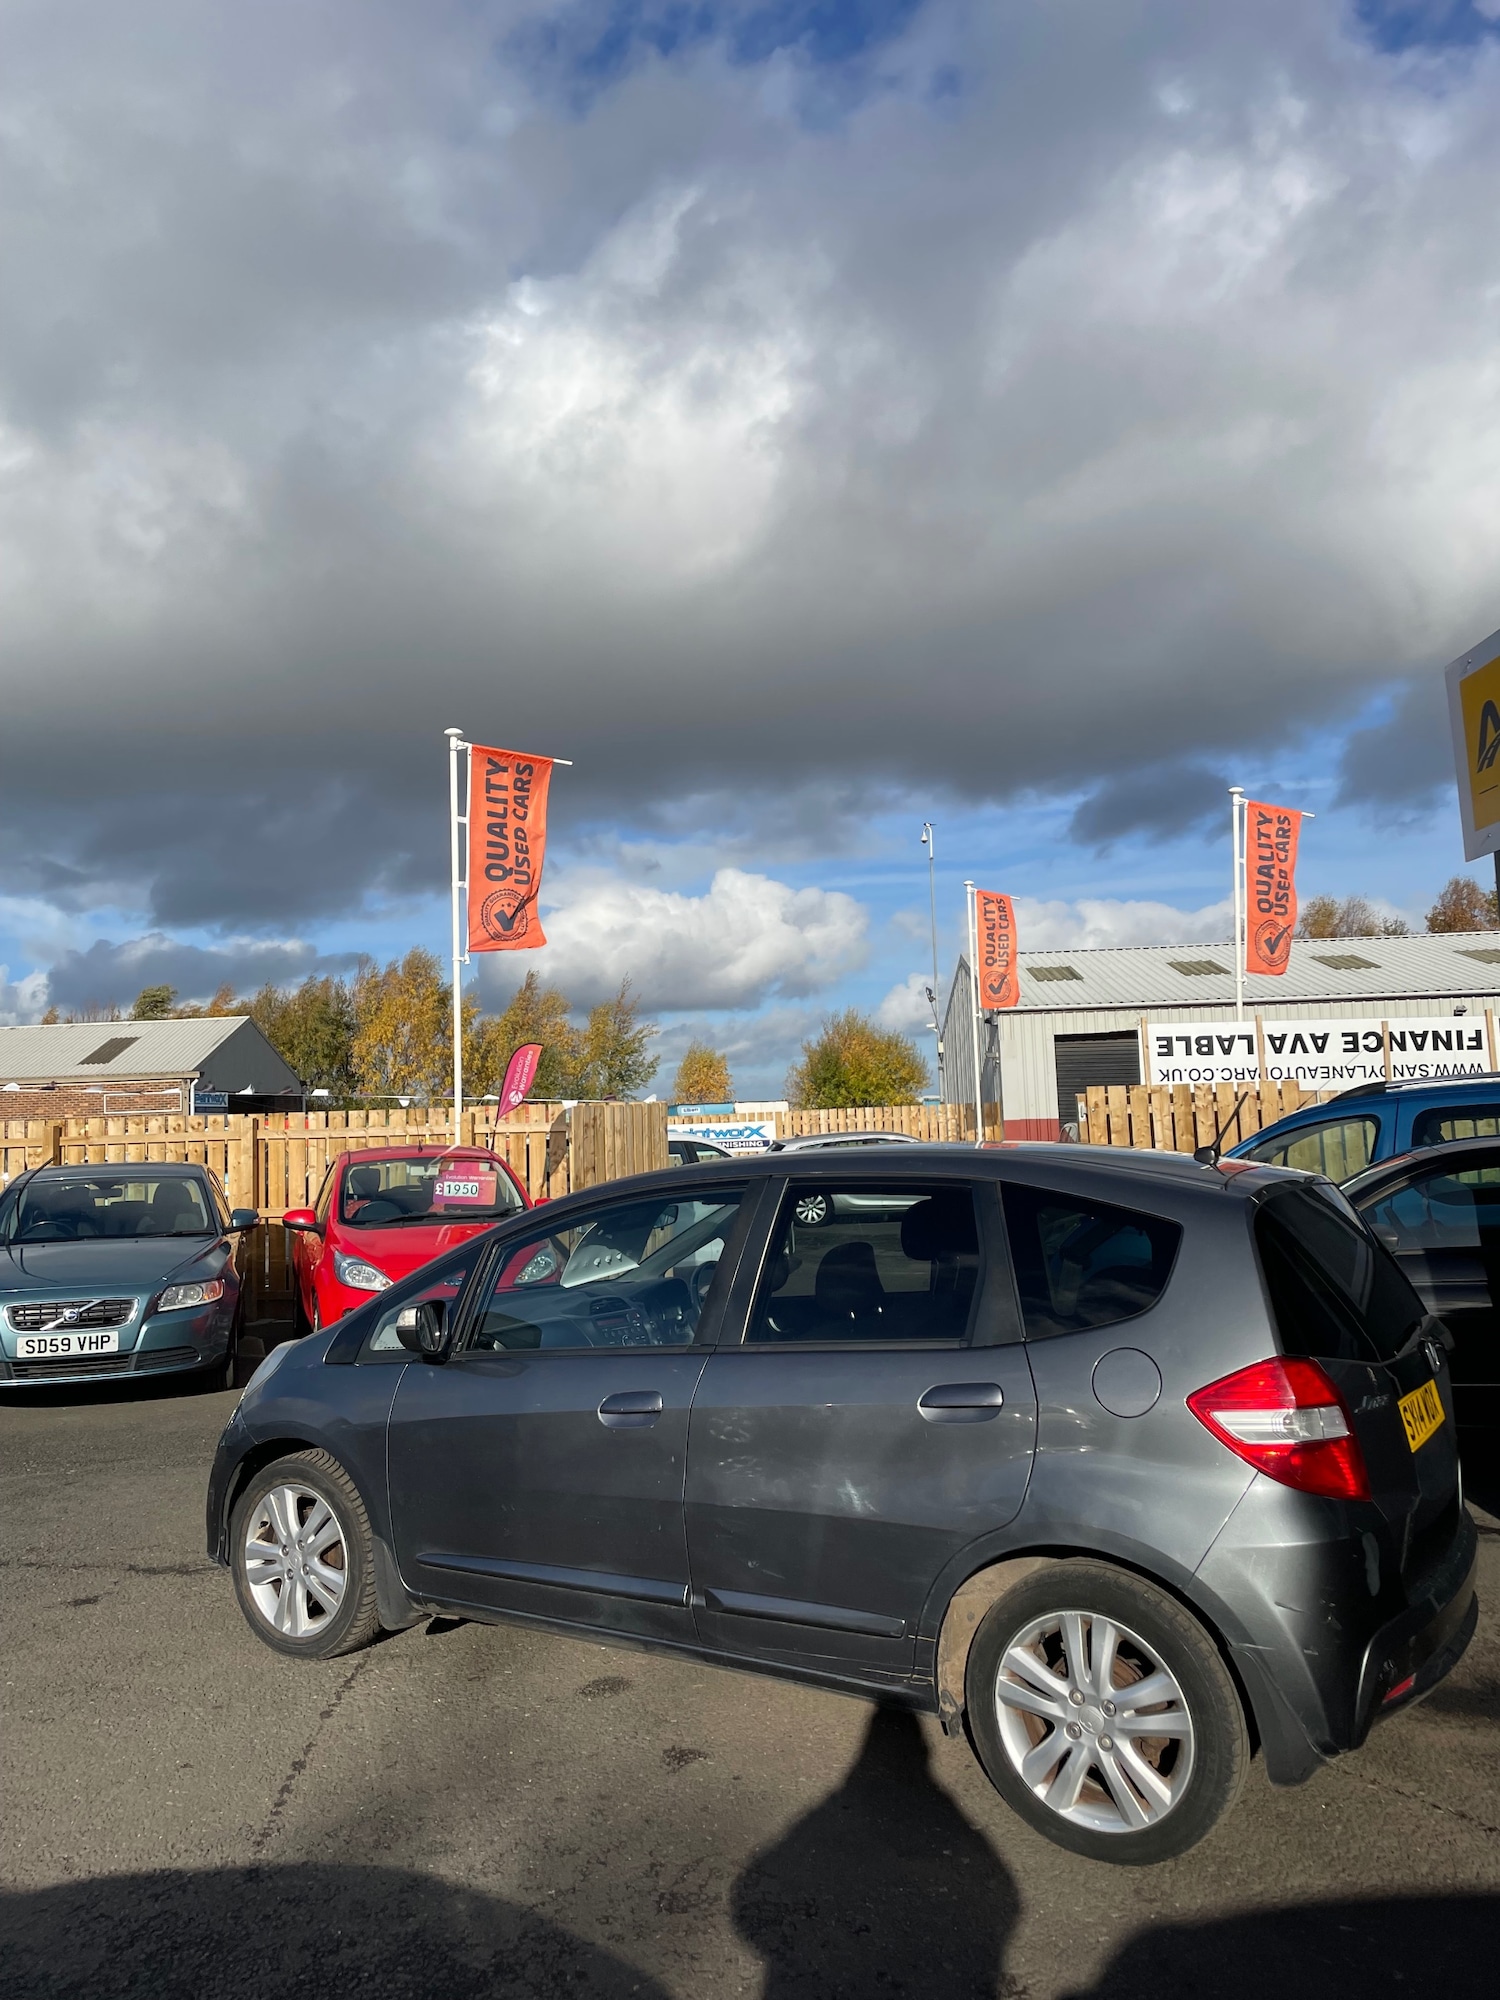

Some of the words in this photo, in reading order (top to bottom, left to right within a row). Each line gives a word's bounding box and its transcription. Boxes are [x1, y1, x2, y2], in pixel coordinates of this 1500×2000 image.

[513, 762, 534, 821] CARS
[484, 757, 513, 882] QUALITY
[1275, 814, 1291, 863] CARS
[513, 827, 531, 885] USED
[1256, 811, 1275, 914] QUALITY
[1274, 868, 1291, 917] USED
[983, 896, 998, 967] QUALITY
[995, 897, 1010, 930] CARS
[997, 933, 1010, 968] USED
[1156, 1032, 1330, 1057] AVALABLE
[1341, 1029, 1483, 1053] FINANCE
[511, 1056, 525, 1090] Evolution
[519, 1050, 534, 1091] Warranties
[435, 1182, 478, 1195] £1950
[25, 1337, 71, 1354] SD59
[77, 1334, 111, 1351] VHP
